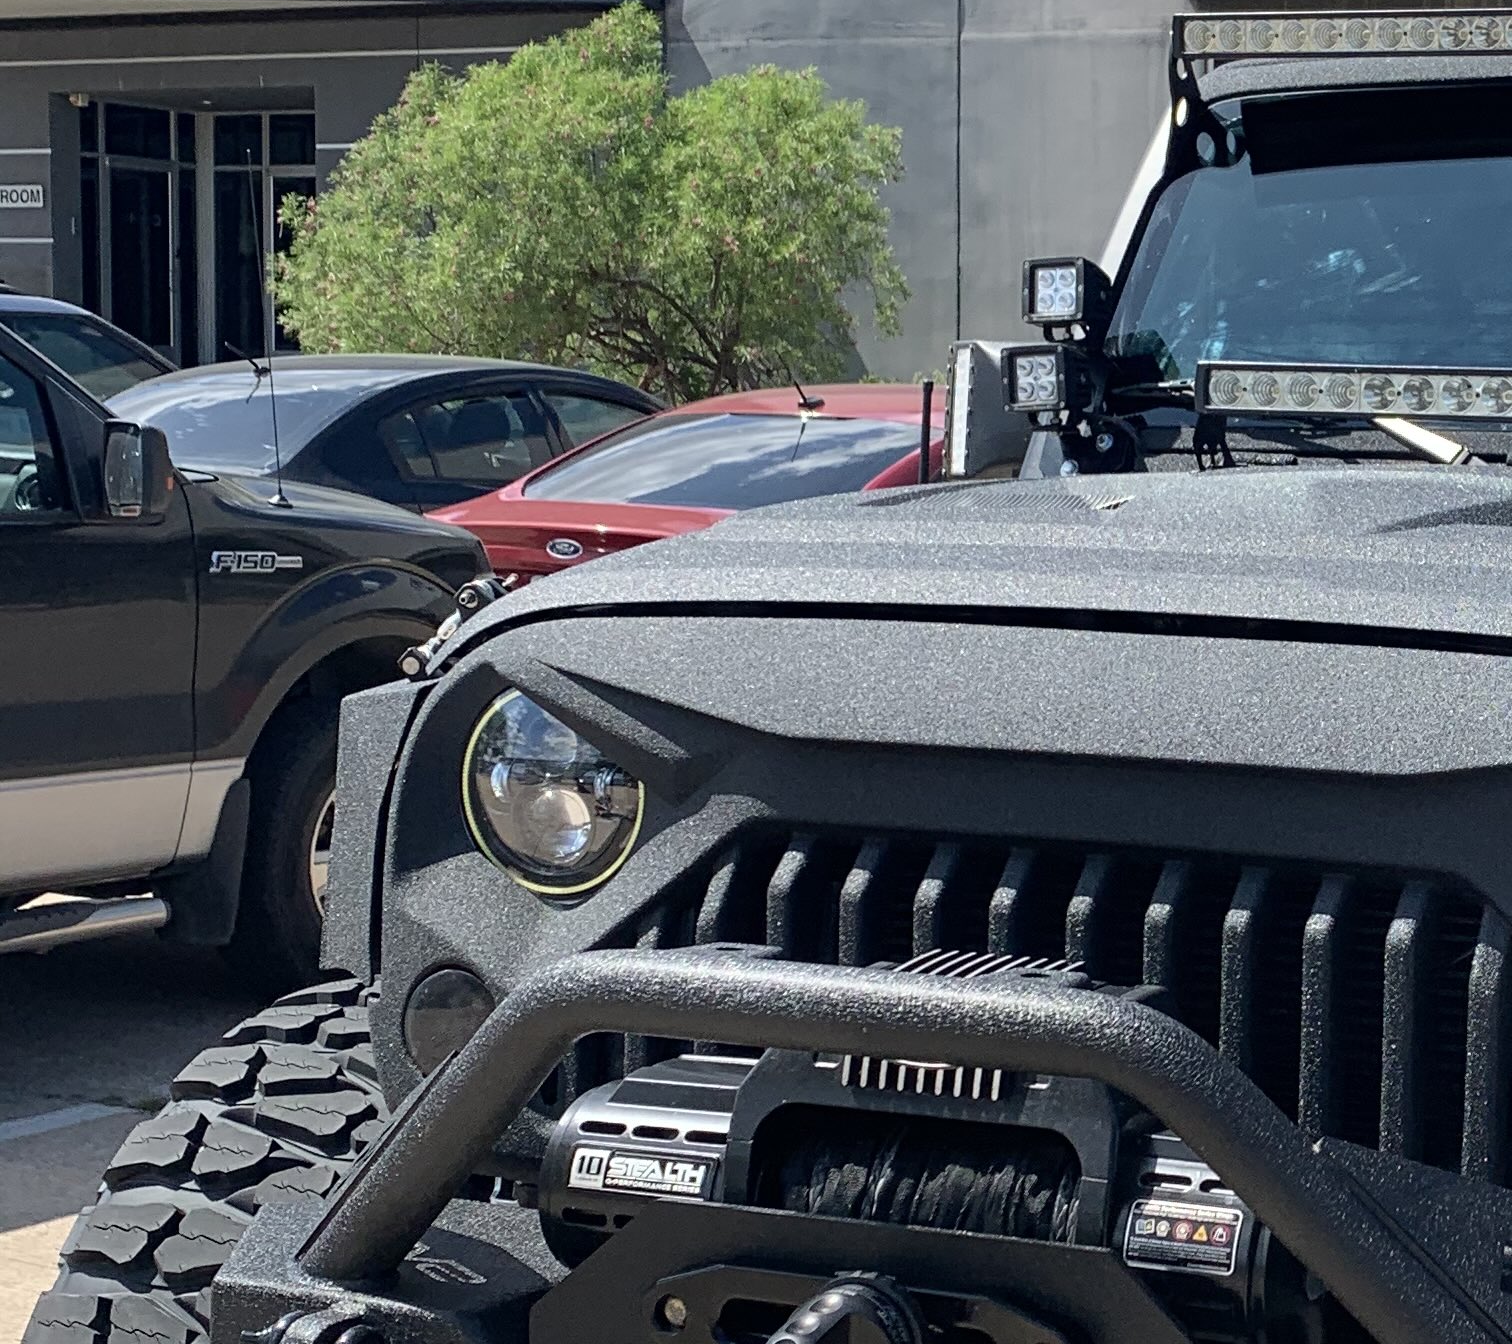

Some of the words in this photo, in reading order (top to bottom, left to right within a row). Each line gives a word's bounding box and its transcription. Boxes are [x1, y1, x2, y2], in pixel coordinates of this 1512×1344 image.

[0, 188, 41, 204] ROOM
[576, 1154, 604, 1176] 10
[606, 1156, 707, 1186] STEALTH
